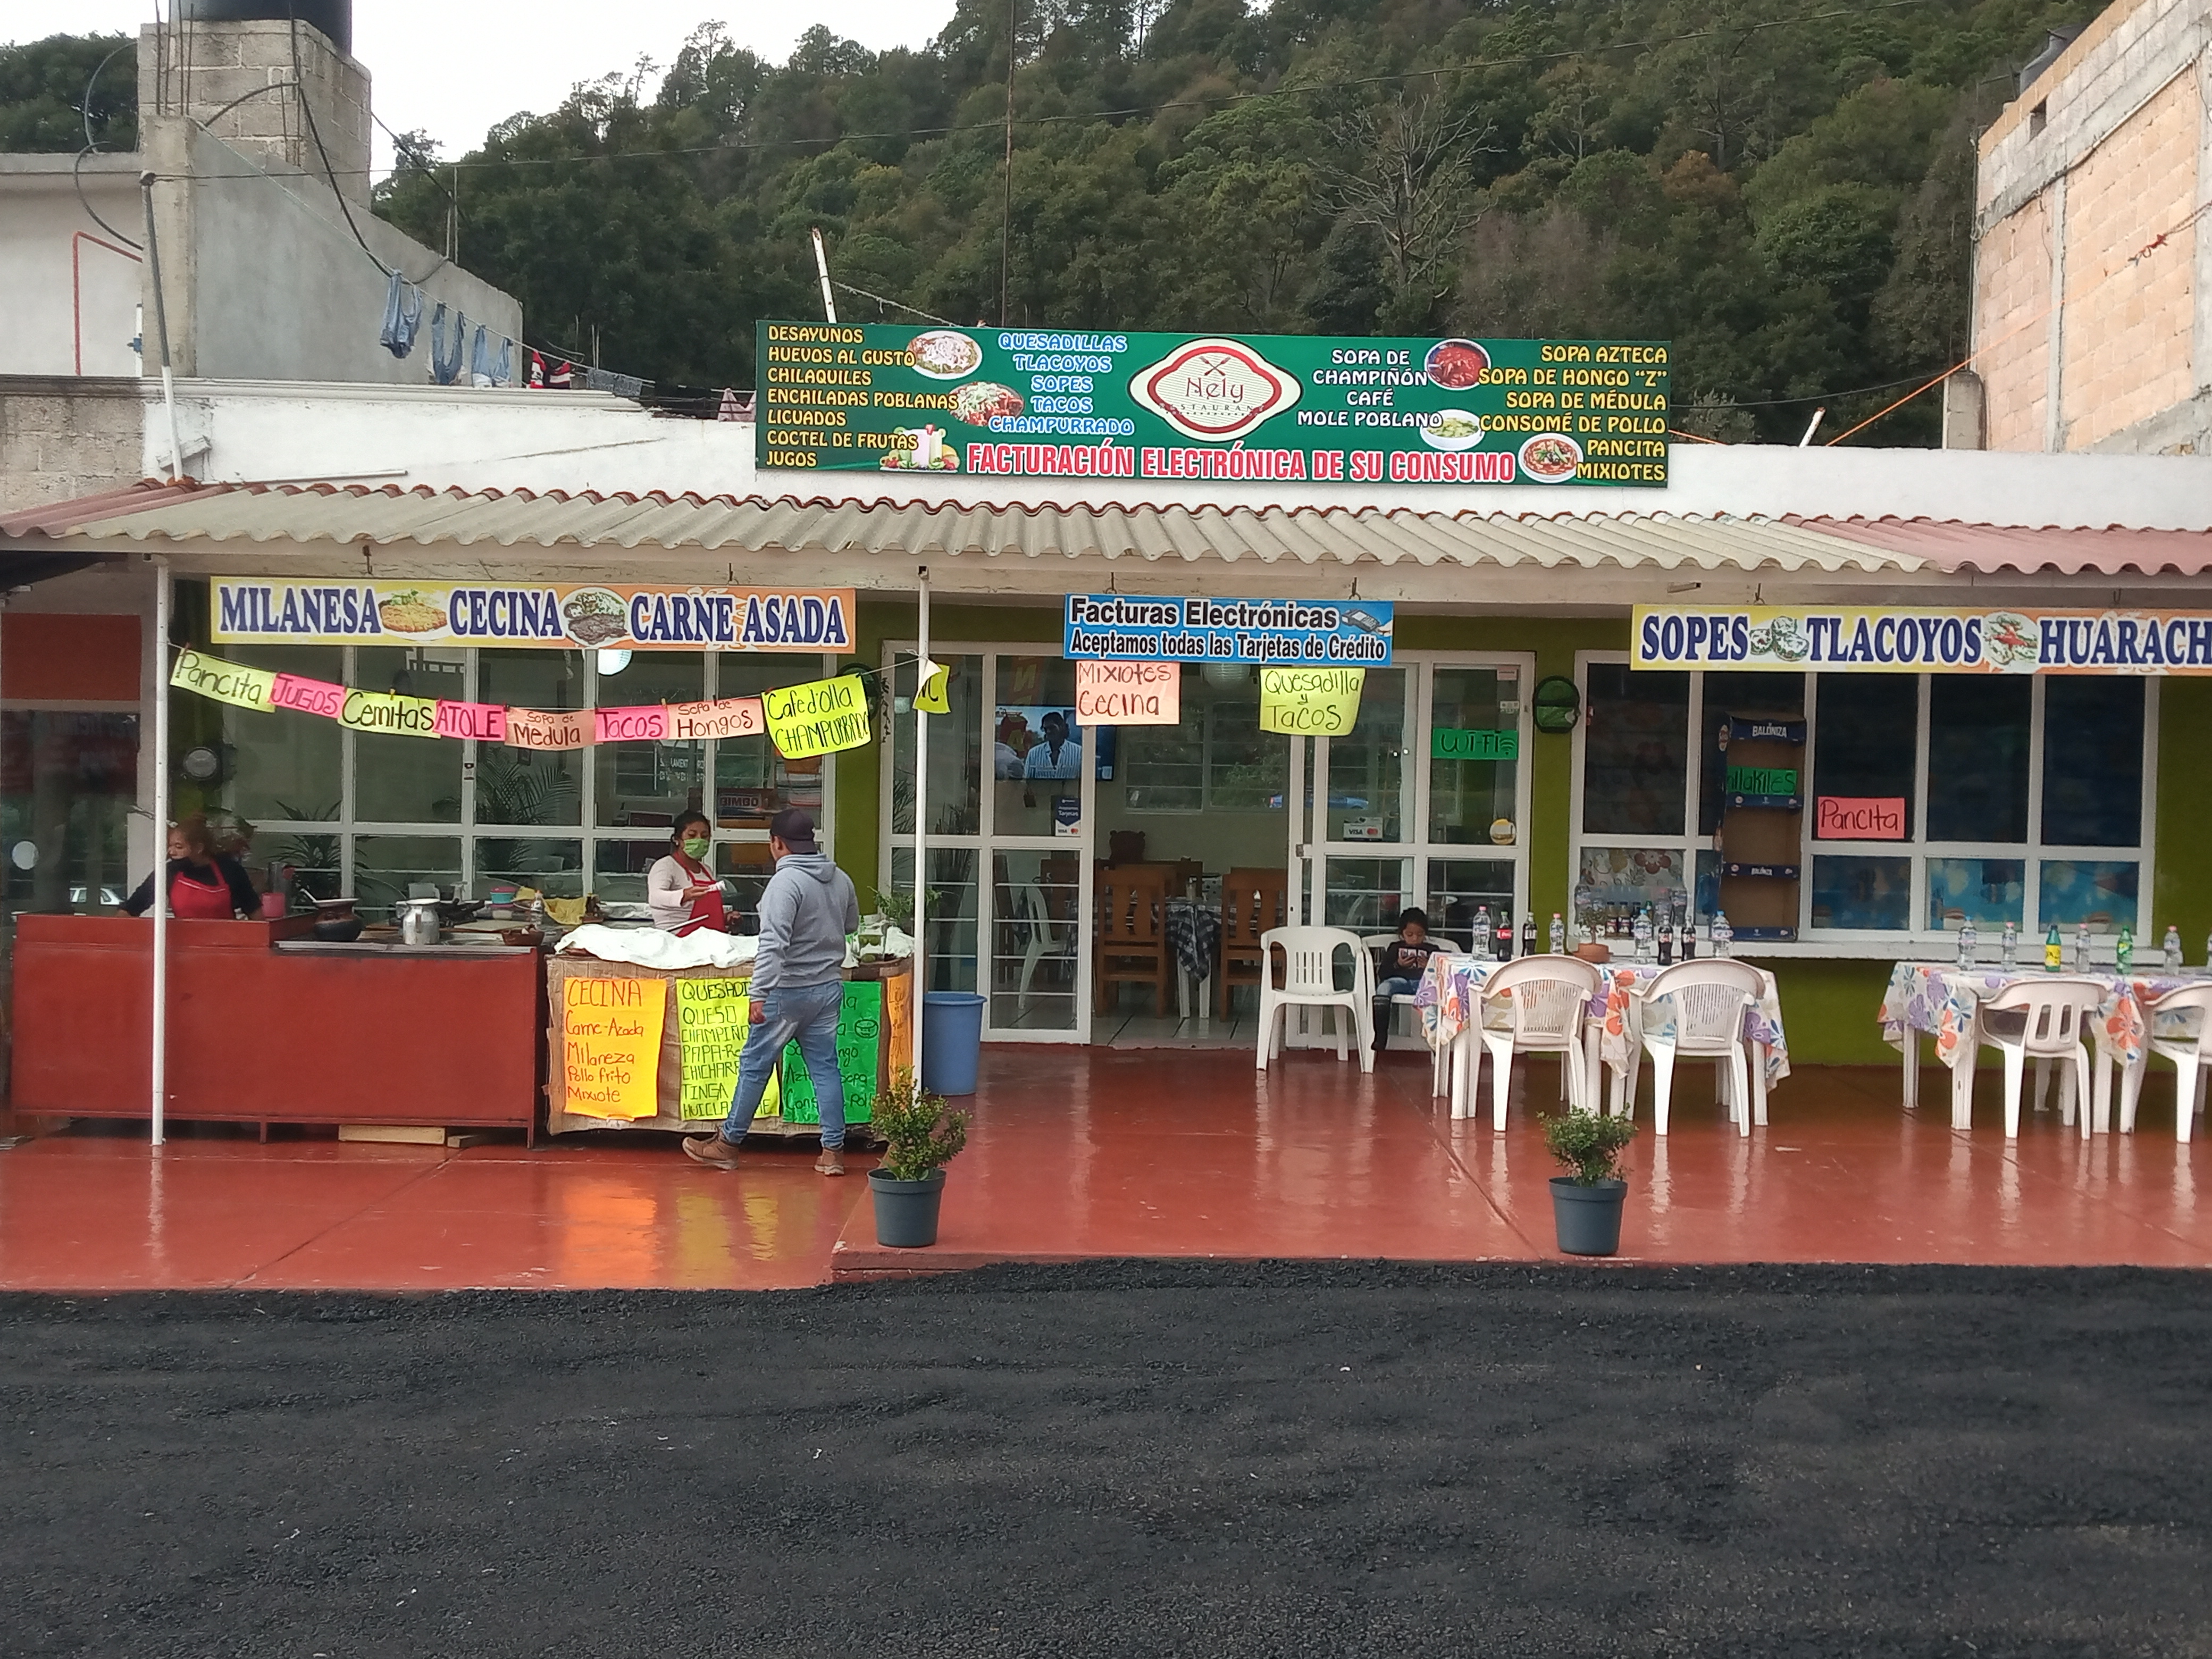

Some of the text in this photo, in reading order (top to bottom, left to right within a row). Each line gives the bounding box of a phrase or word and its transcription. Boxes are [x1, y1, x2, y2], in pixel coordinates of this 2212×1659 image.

[768, 325, 863, 343] DESAYUNOS
[998, 333, 1128, 353] QUESADILLAS
[768, 347, 916, 367] HUEVOS AL GUSTO
[1013, 354, 1112, 373] TLACOYOS
[1332, 349, 1410, 365] SOPA DE
[1541, 345, 1668, 363] SOPA AZTECA
[767, 368, 872, 386] CHILAQUILES
[1031, 375, 1094, 393] SOPES
[1313, 370, 1428, 387] CHAMPIÑÓN
[1478, 368, 1528, 386] SOPA
[1534, 369, 1556, 385] DE
[1562, 369, 1630, 386] HONGO
[768, 389, 959, 411] ENCHILADAS POBLANAS
[1185, 377, 1244, 404] Nely
[1346, 389, 1394, 407] CAFÉ
[1506, 386, 1666, 410] SOPA DE MÉDULA
[1030, 396, 1094, 414] TACOS
[1159, 403, 1264, 412] RESTAURANT
[768, 409, 846, 426] LICUADOS
[988, 416, 1134, 435] CHAMPURRADO
[1297, 410, 1443, 428] MOLE POBLANO
[1479, 412, 1666, 434] CONSOMÉ DE POLLO
[767, 430, 918, 450] COCTEL DE FRUTAS
[1587, 440, 1665, 457] PANCITA
[766, 451, 817, 467] JUGOS
[968, 438, 1515, 482] FACTURACIÓN ELECTRÓNICA DE SU CONSUMO
[1576, 463, 1665, 480] MIXIOTES
[220, 586, 381, 633] MILANESA
[449, 590, 562, 637] CECINA
[631, 595, 847, 644] CARNE ASADA
[1071, 598, 1338, 629] Facturas Electrónicas
[1071, 629, 1385, 663] Aceptamos todas las Tarjetas de Crédito
[1642, 615, 1748, 661] SOPES
[1806, 617, 1982, 664] TLACOYOS
[2039, 619, 2212, 665] HUARACH
[175, 650, 262, 705] Pancita
[1264, 671, 1359, 696] Quesadilla
[270, 677, 340, 715] JUGOS
[1079, 691, 1159, 717] Cecina
[1298, 694, 1309, 705] y
[342, 692, 434, 731] Cemitas
[436, 705, 502, 739] ATOLE
[677, 710, 753, 738] Hongos
[720, 797, 759, 806] BIMBO
[1820, 800, 1898, 832] Pancita
[568, 979, 642, 1007] CECINA
[682, 981, 751, 1001] QUESADI
[683, 1006, 737, 1027] QUESO
[681, 1024, 749, 1043] CHAMPIÑO
[567, 1066, 594, 1082] Pollo
[568, 1086, 621, 1102] Mixiote
[682, 1083, 728, 1100] TINGA
